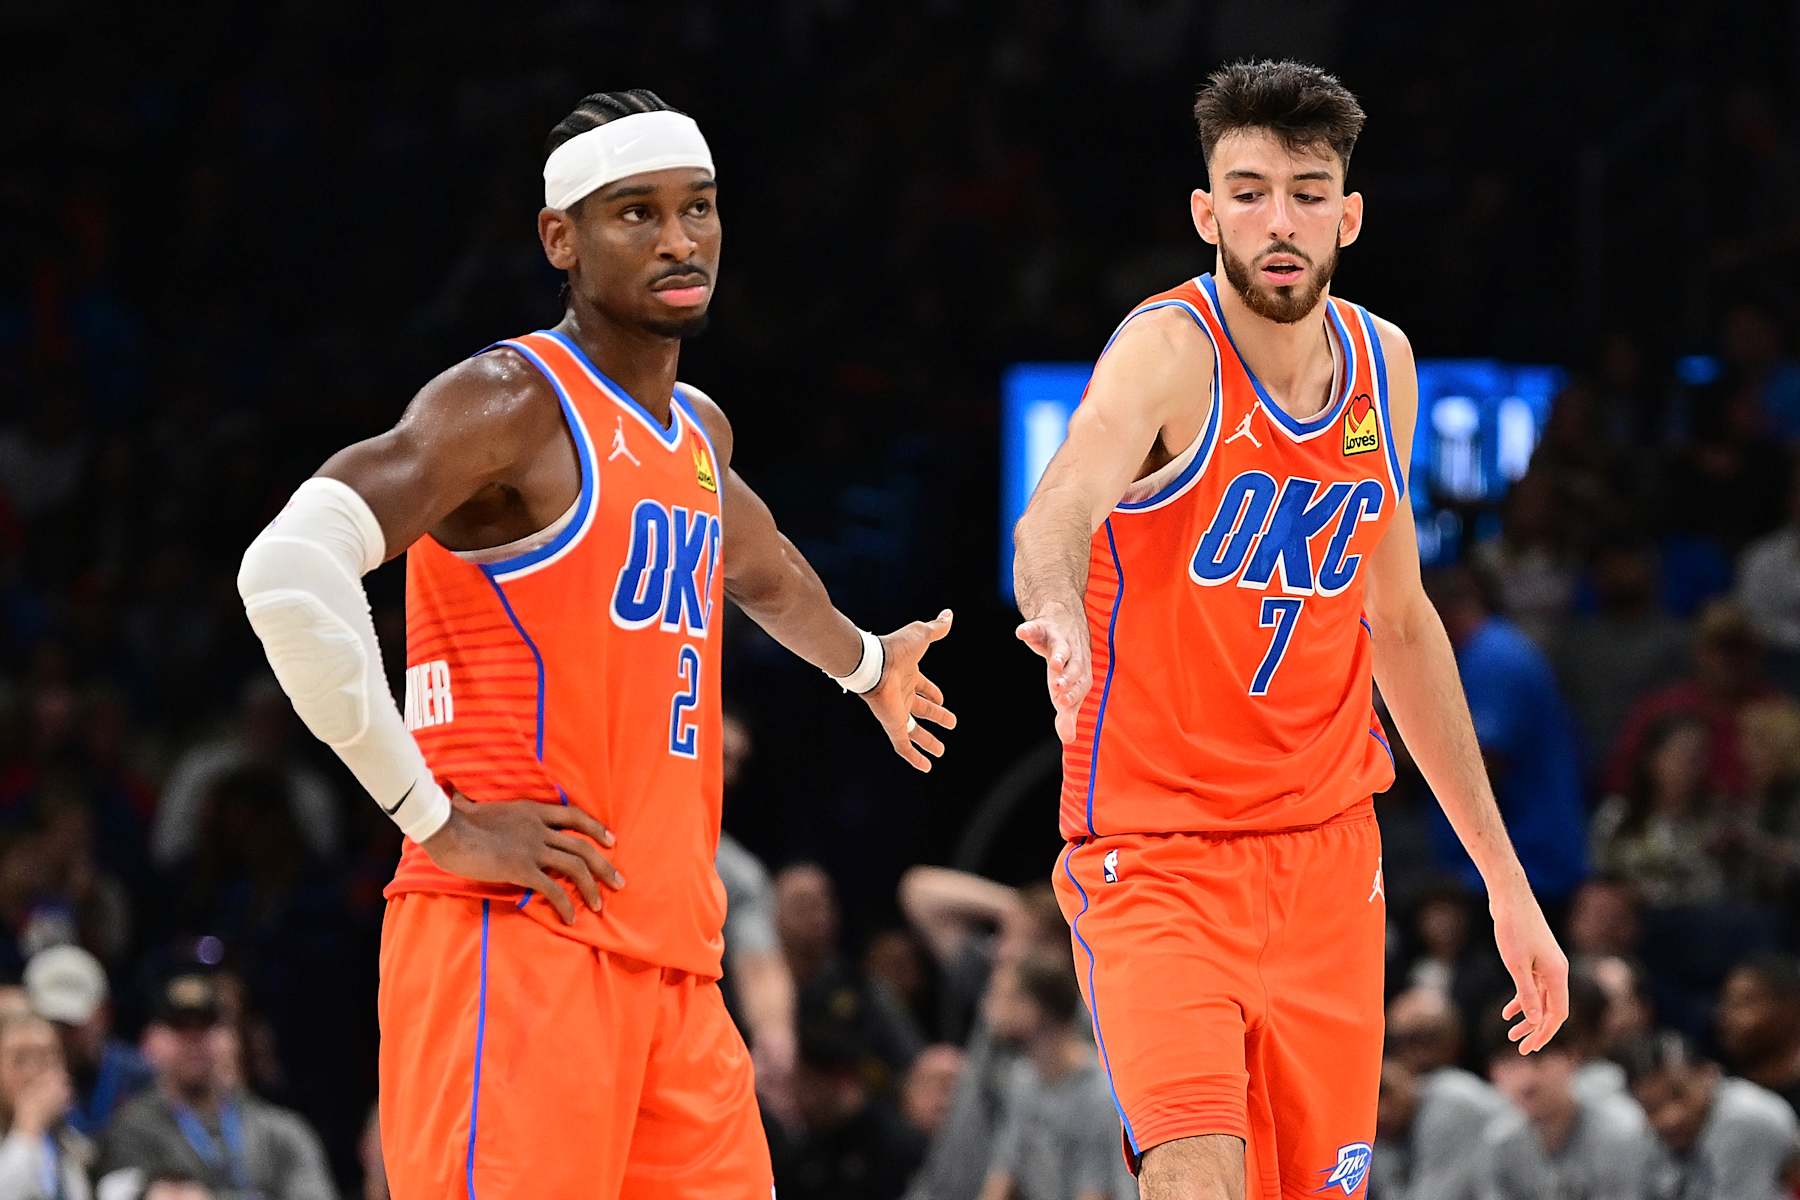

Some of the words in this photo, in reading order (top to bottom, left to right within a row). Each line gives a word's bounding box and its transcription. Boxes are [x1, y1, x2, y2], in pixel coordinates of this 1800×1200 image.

[1188, 469, 1385, 598] OKC
[669, 643, 701, 760] 2
[1249, 597, 1304, 696] 7
